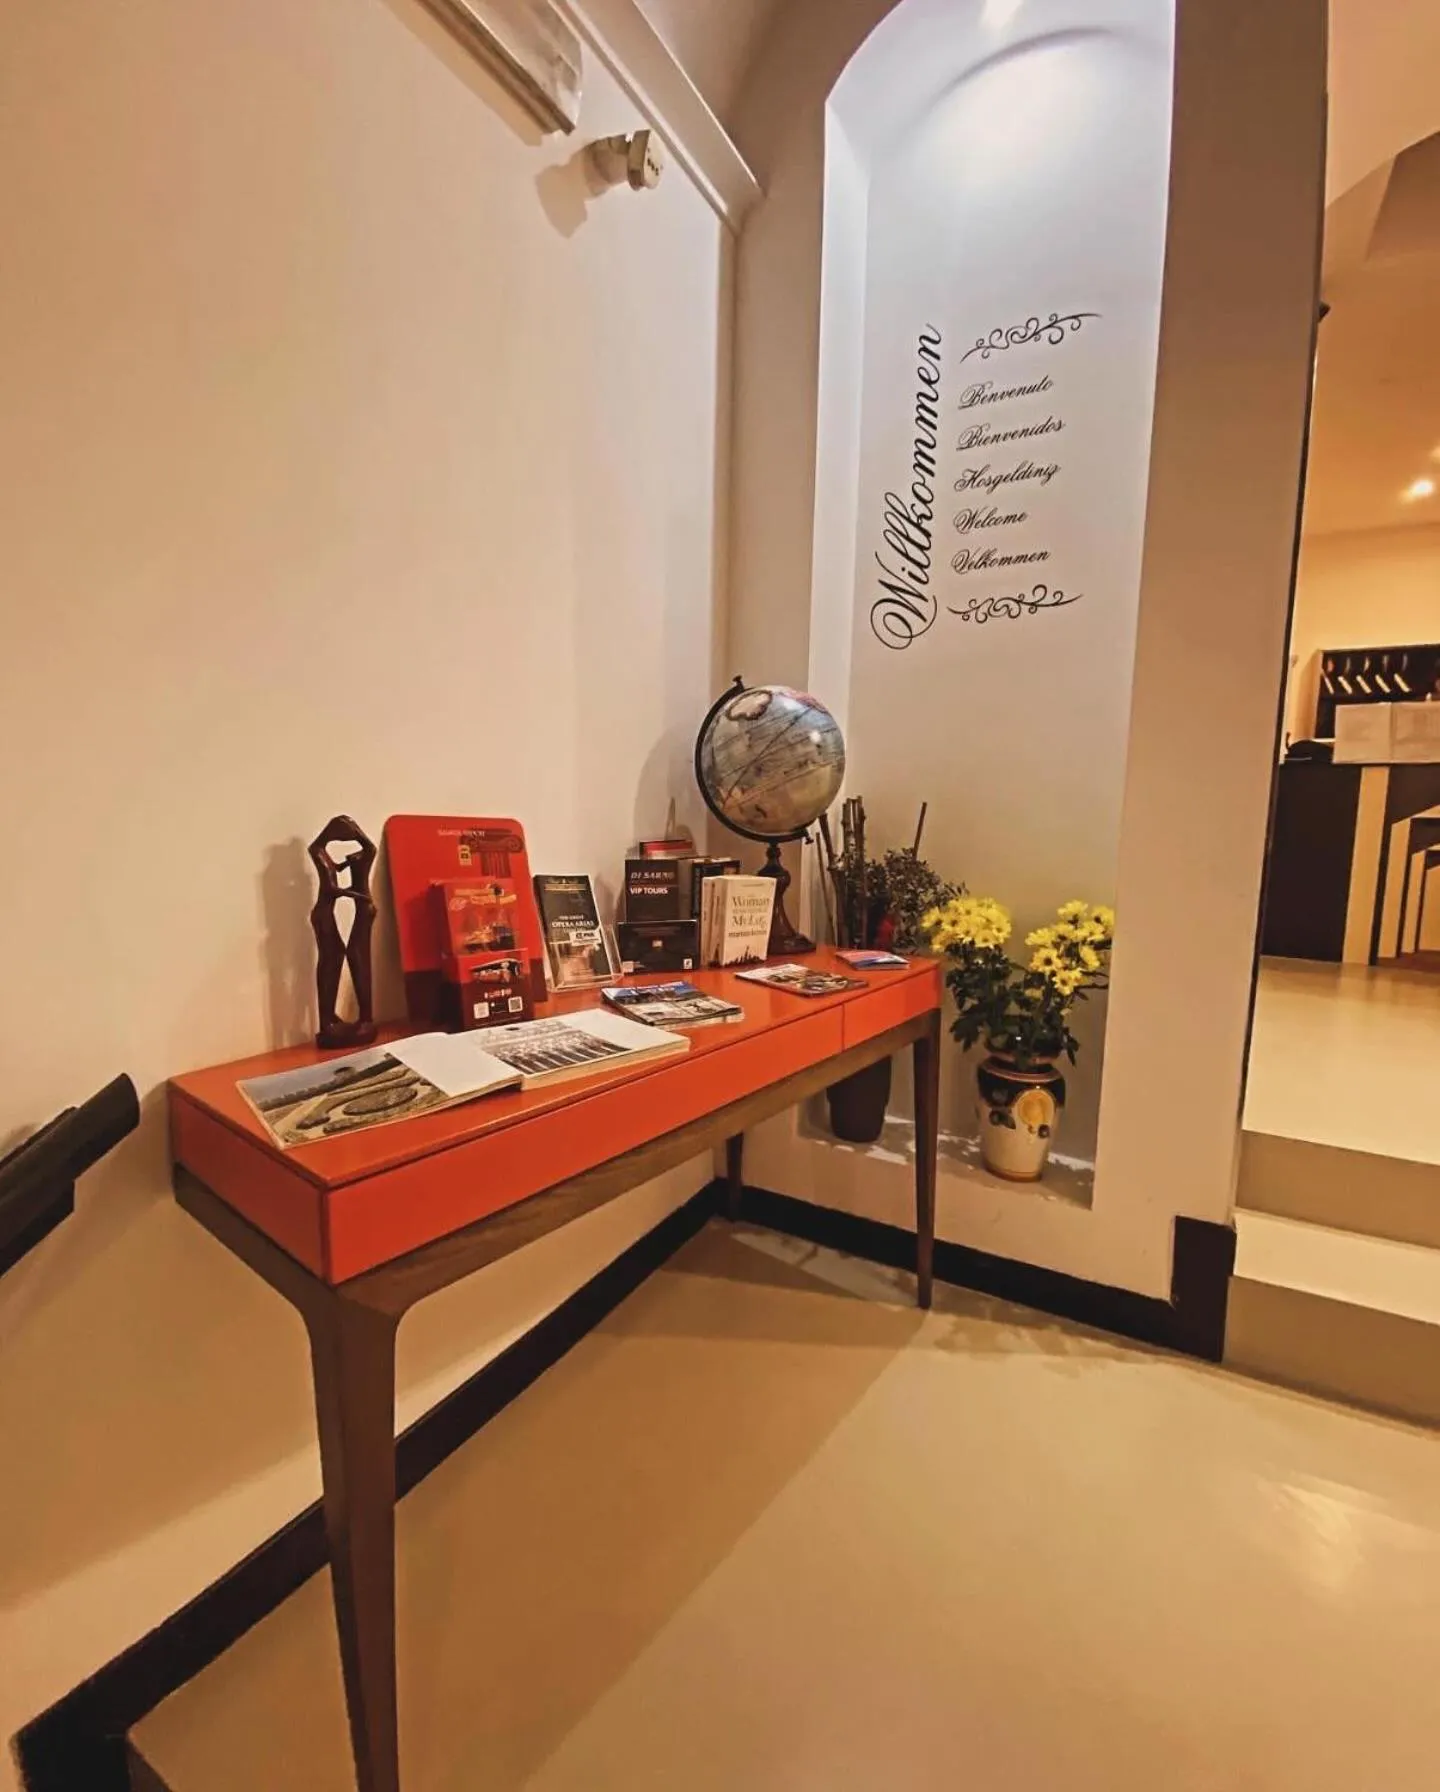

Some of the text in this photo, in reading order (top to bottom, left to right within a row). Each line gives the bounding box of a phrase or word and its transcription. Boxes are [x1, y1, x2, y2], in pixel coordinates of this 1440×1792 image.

[958, 375, 1054, 410] Benvenuto
[955, 415, 1066, 452] Bienvenidos
[870, 323, 942, 650] Willkommen
[953, 506, 1028, 535] Welcome
[951, 548, 1051, 575] Velkommen
[630, 887, 669, 895] VIP TOURS
